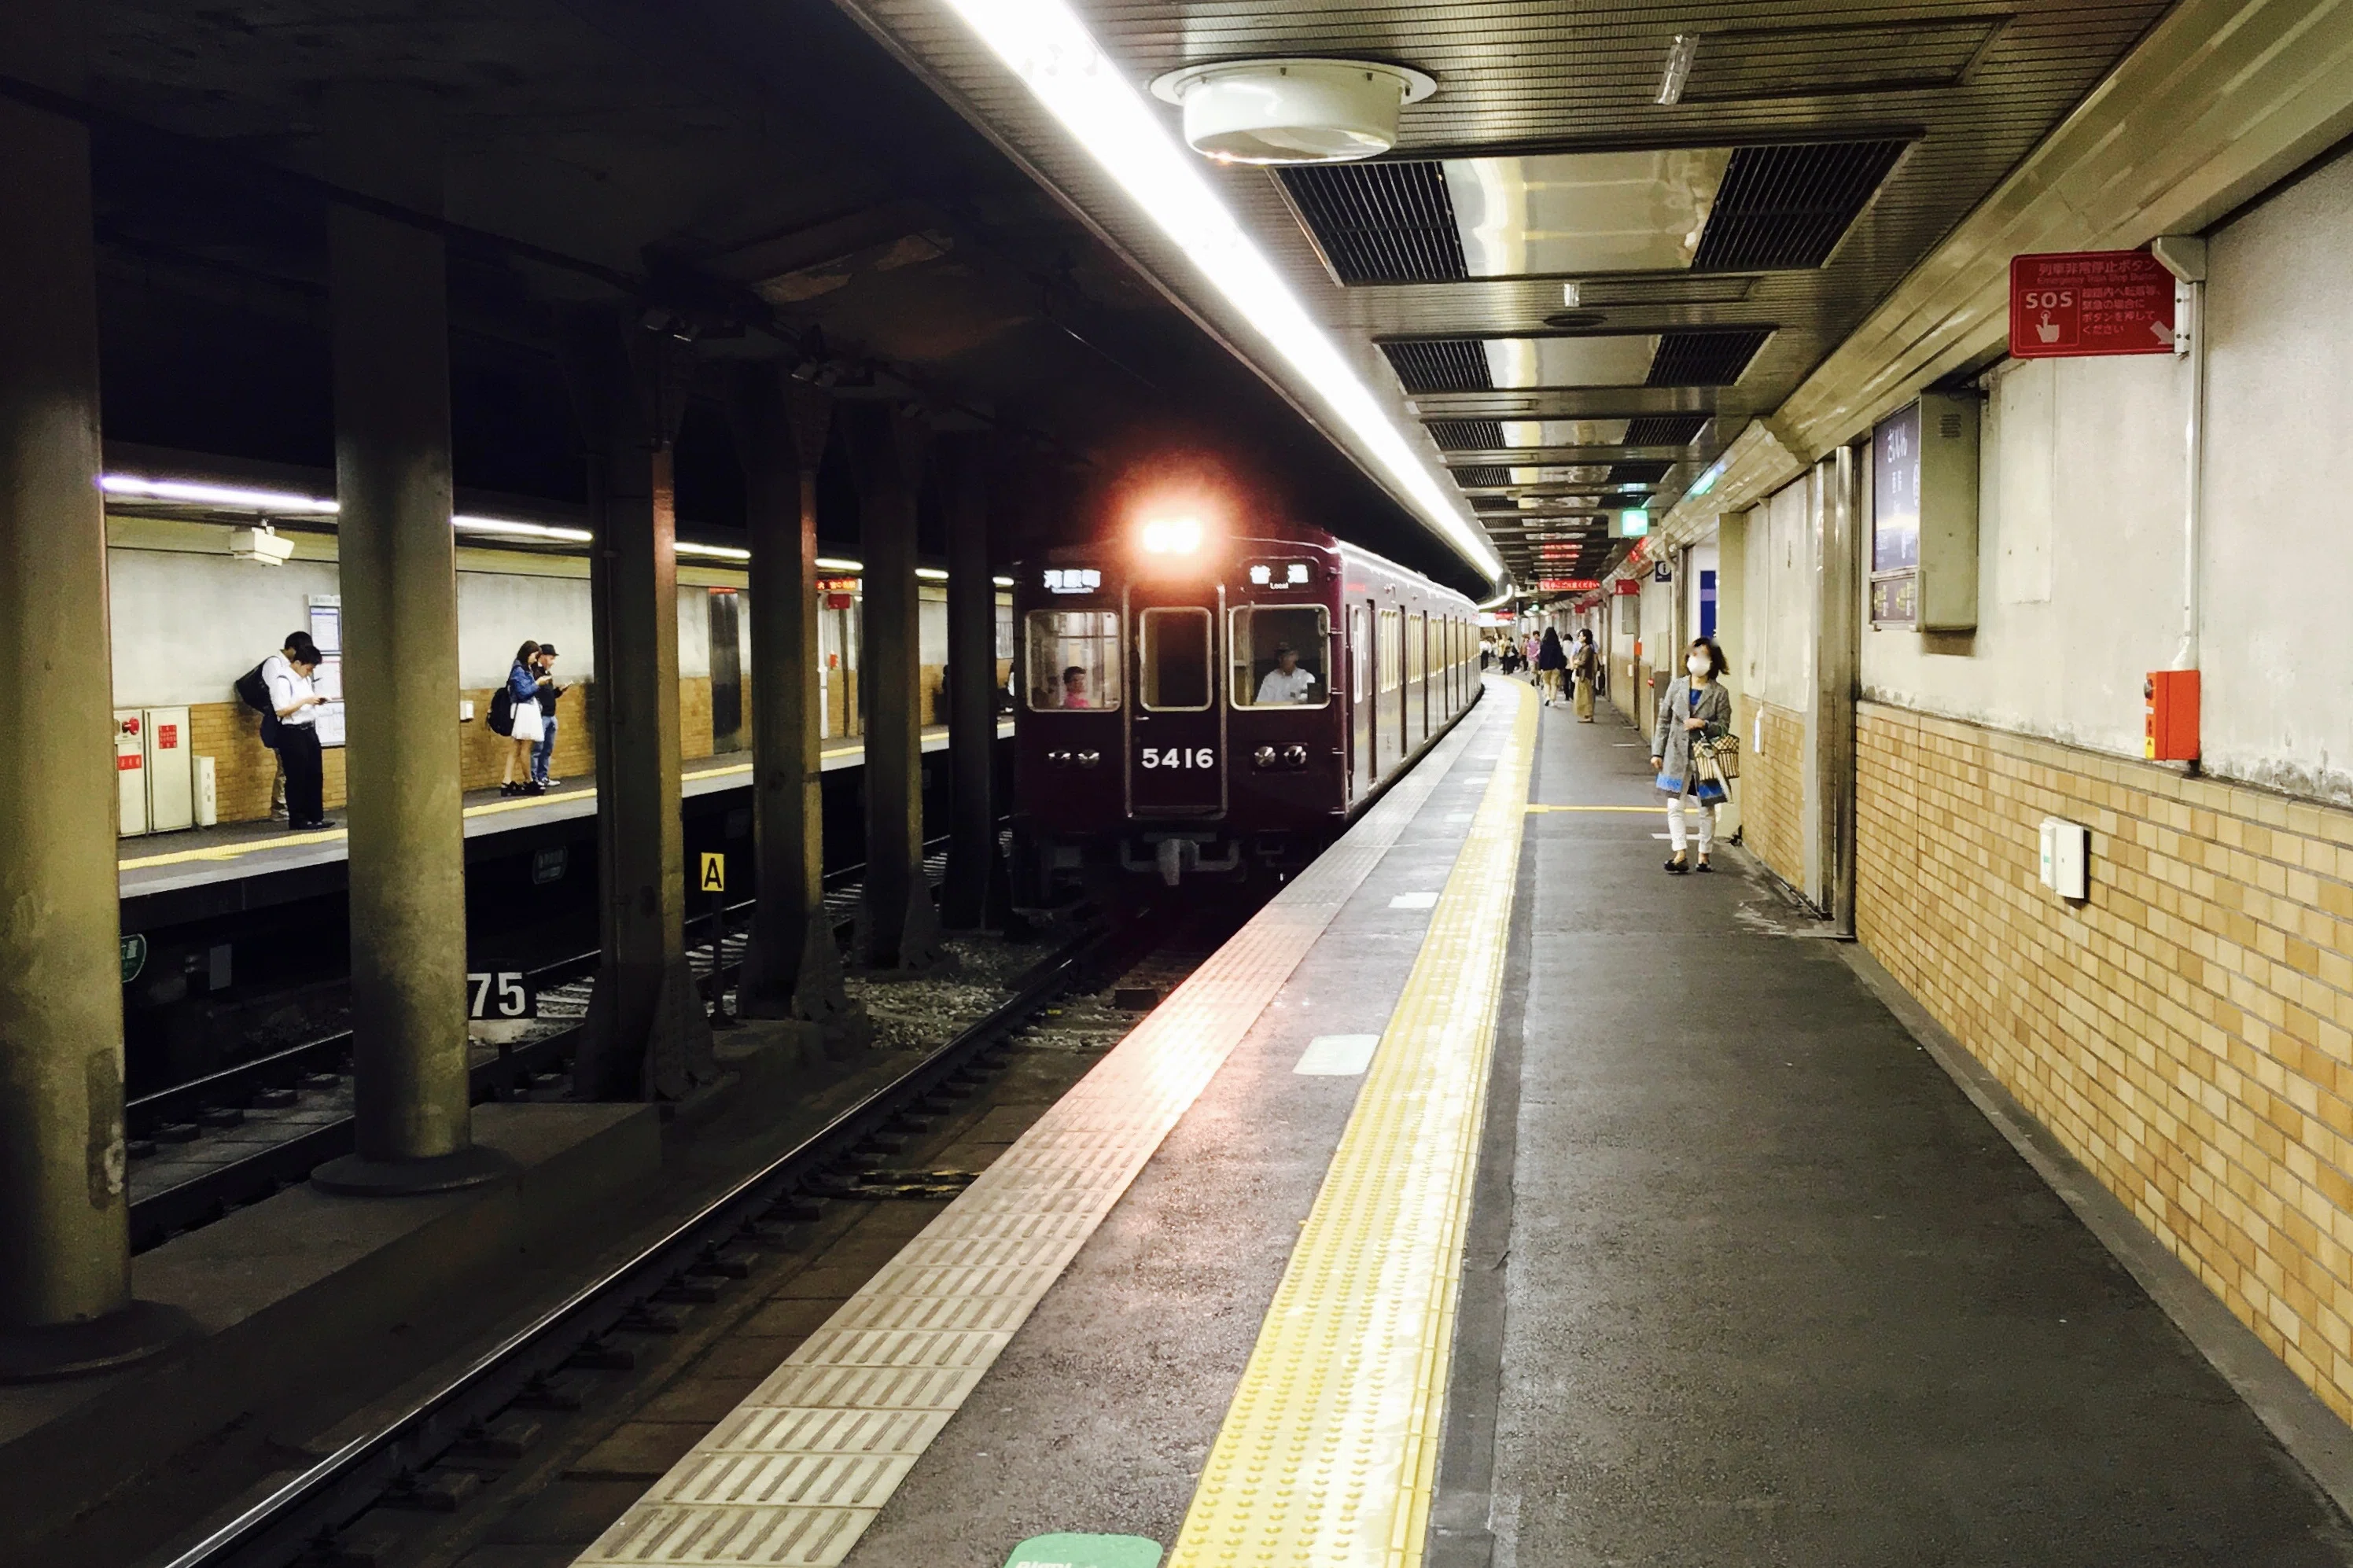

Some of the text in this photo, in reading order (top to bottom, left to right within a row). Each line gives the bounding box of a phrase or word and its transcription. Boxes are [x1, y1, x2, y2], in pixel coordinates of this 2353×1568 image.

[2038, 260, 2156, 275] 列車非常停止ボタン
[2025, 291, 2073, 309] SOS
[2082, 311, 2155, 322] ボタンを押して
[2082, 324, 2125, 335] ください
[1141, 748, 1214, 769] 5416
[704, 857, 722, 889] A
[467, 972, 525, 1017] 75
